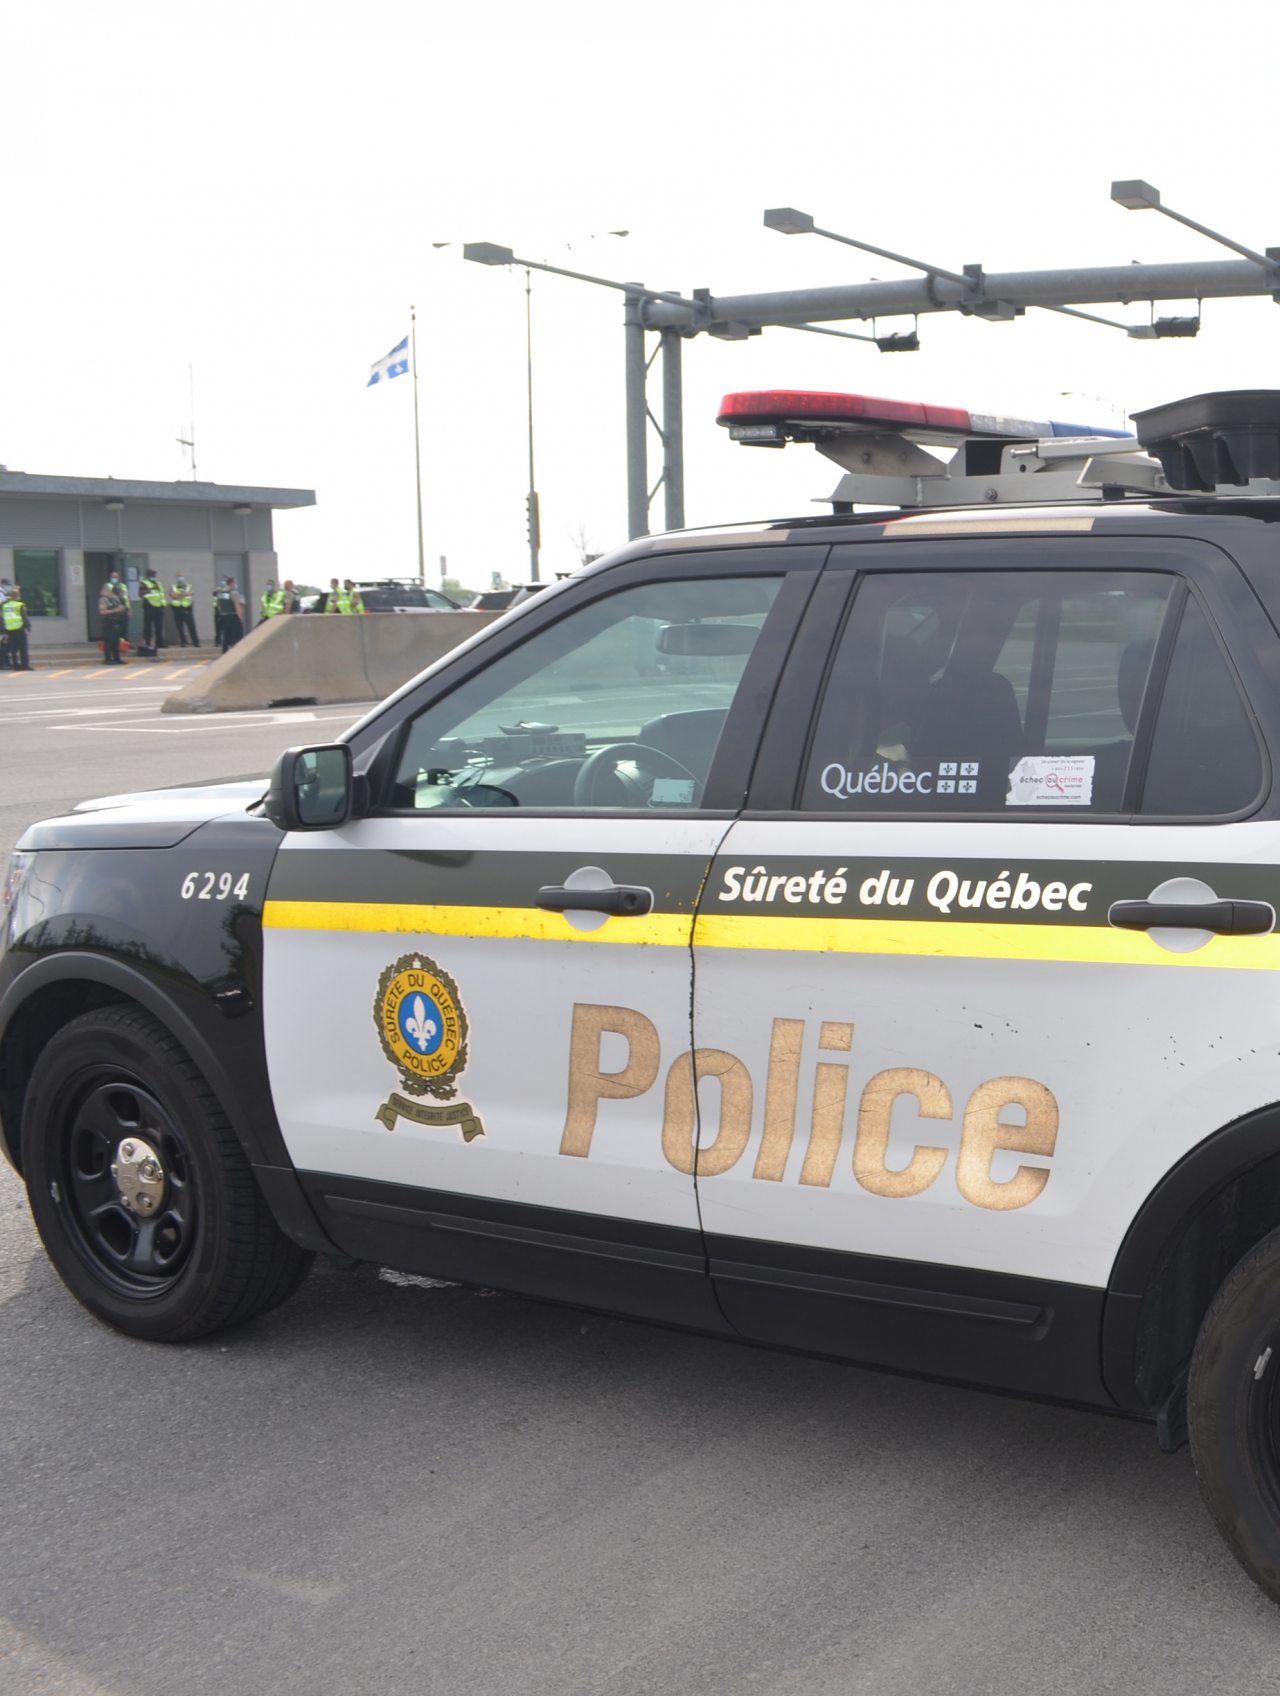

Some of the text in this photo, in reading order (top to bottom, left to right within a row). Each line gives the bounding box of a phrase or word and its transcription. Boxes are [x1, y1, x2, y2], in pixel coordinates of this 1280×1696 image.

[821, 762, 932, 799] Québec
[1019, 775, 1044, 784] échec
[1059, 776, 1083, 784] crime
[181, 871, 250, 900] 6294
[718, 865, 1093, 913] Sûreté du Québec
[407, 973, 425, 988] DU
[402, 1049, 448, 1074] POLICE
[559, 1002, 1060, 1212] Police
